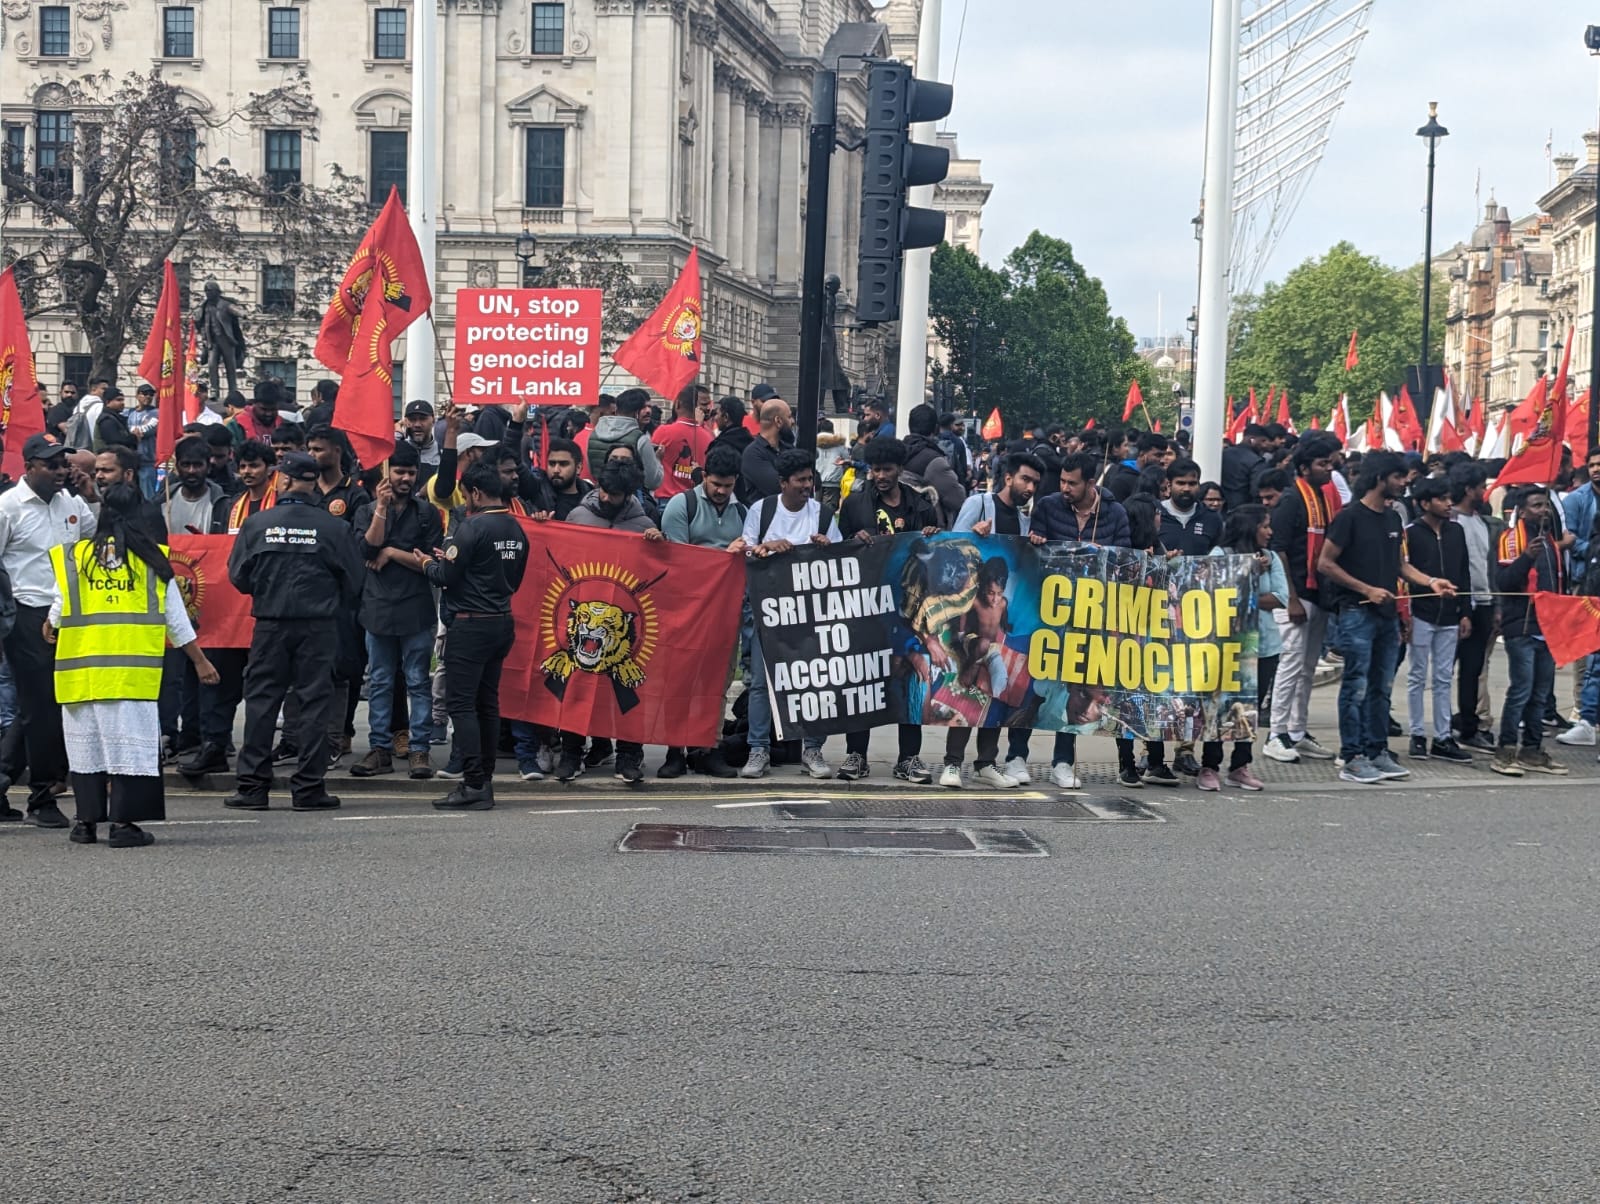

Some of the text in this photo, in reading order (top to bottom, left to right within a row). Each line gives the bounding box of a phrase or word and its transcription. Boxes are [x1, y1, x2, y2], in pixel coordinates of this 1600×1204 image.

[478, 295, 580, 318] UN, stop
[467, 323, 589, 345] protecting
[469, 349, 585, 372] genocidal
[470, 376, 582, 396] Sri Lanka
[288, 537, 317, 545] GUARD
[791, 556, 861, 592] HOLD
[106, 594, 119, 605] 41
[761, 584, 896, 628] SRI LANKA
[1040, 574, 1238, 640] CRIME OF
[814, 622, 850, 655] TO
[774, 648, 894, 692] ACCOUNT
[1028, 628, 1242, 694] GENOCIDE
[787, 681, 887, 723] FOR THE
